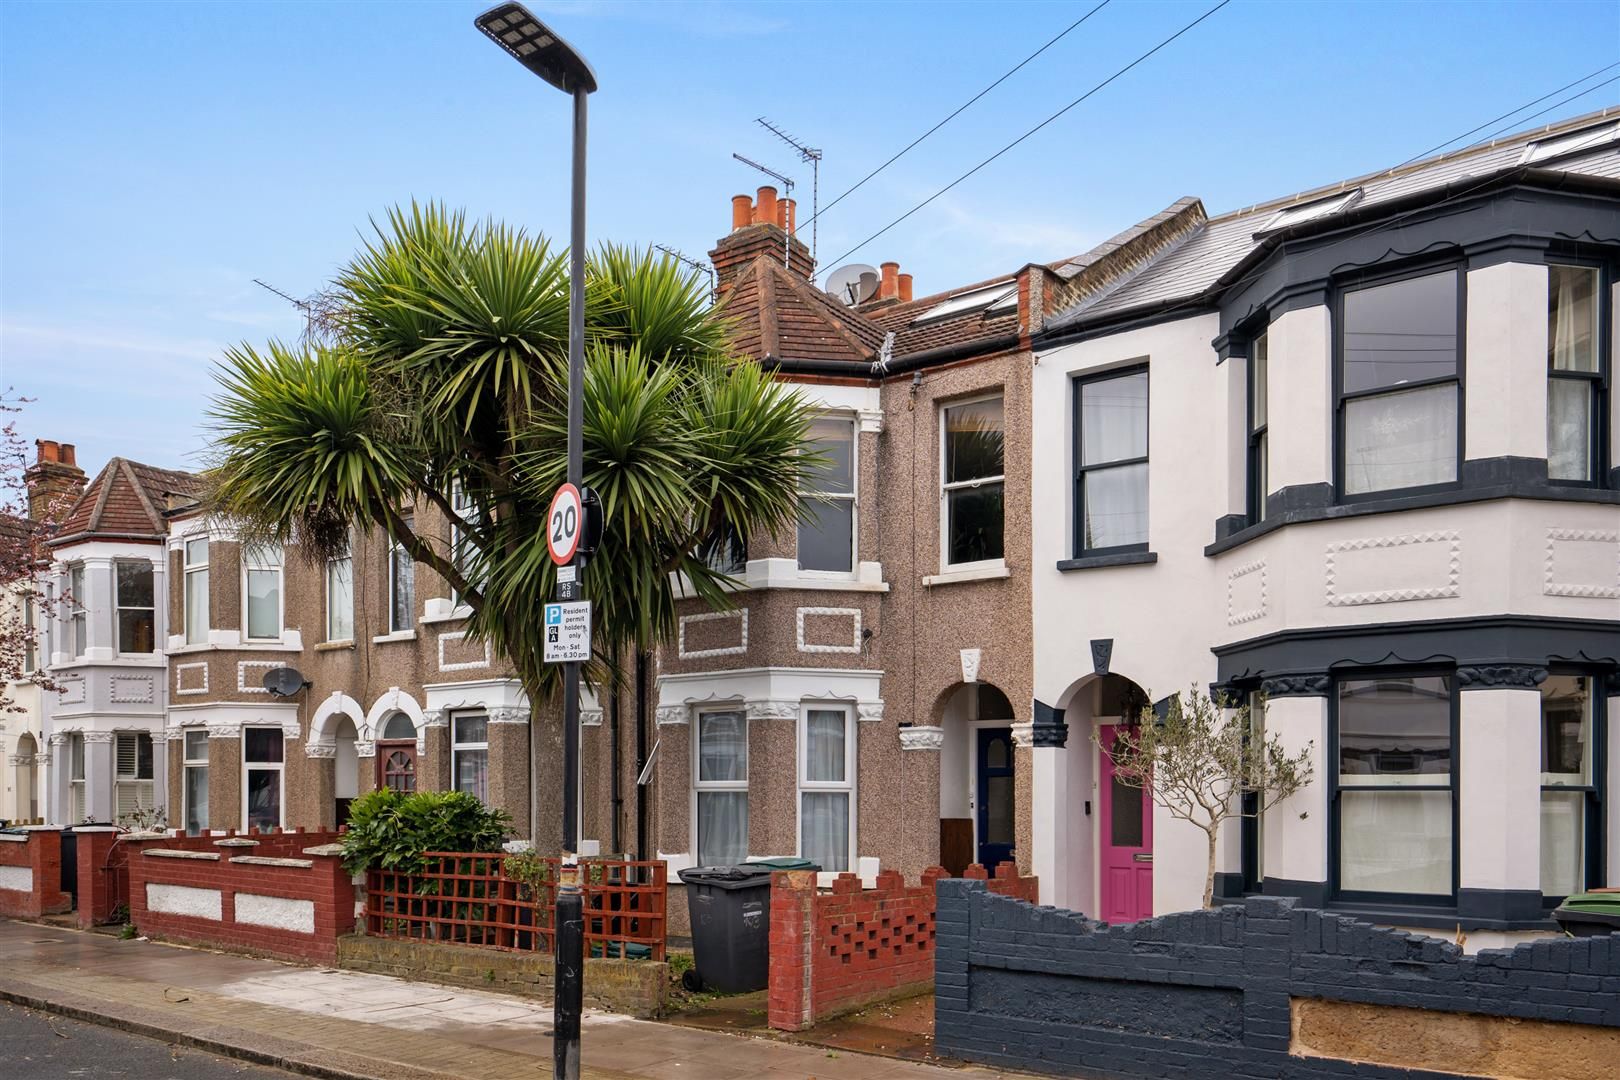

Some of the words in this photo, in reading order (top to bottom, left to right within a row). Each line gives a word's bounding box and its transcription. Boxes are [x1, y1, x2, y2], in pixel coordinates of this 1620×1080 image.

[553, 505, 576, 543] 20
[562, 590, 571, 598] 4B
[550, 608, 560, 623] P
